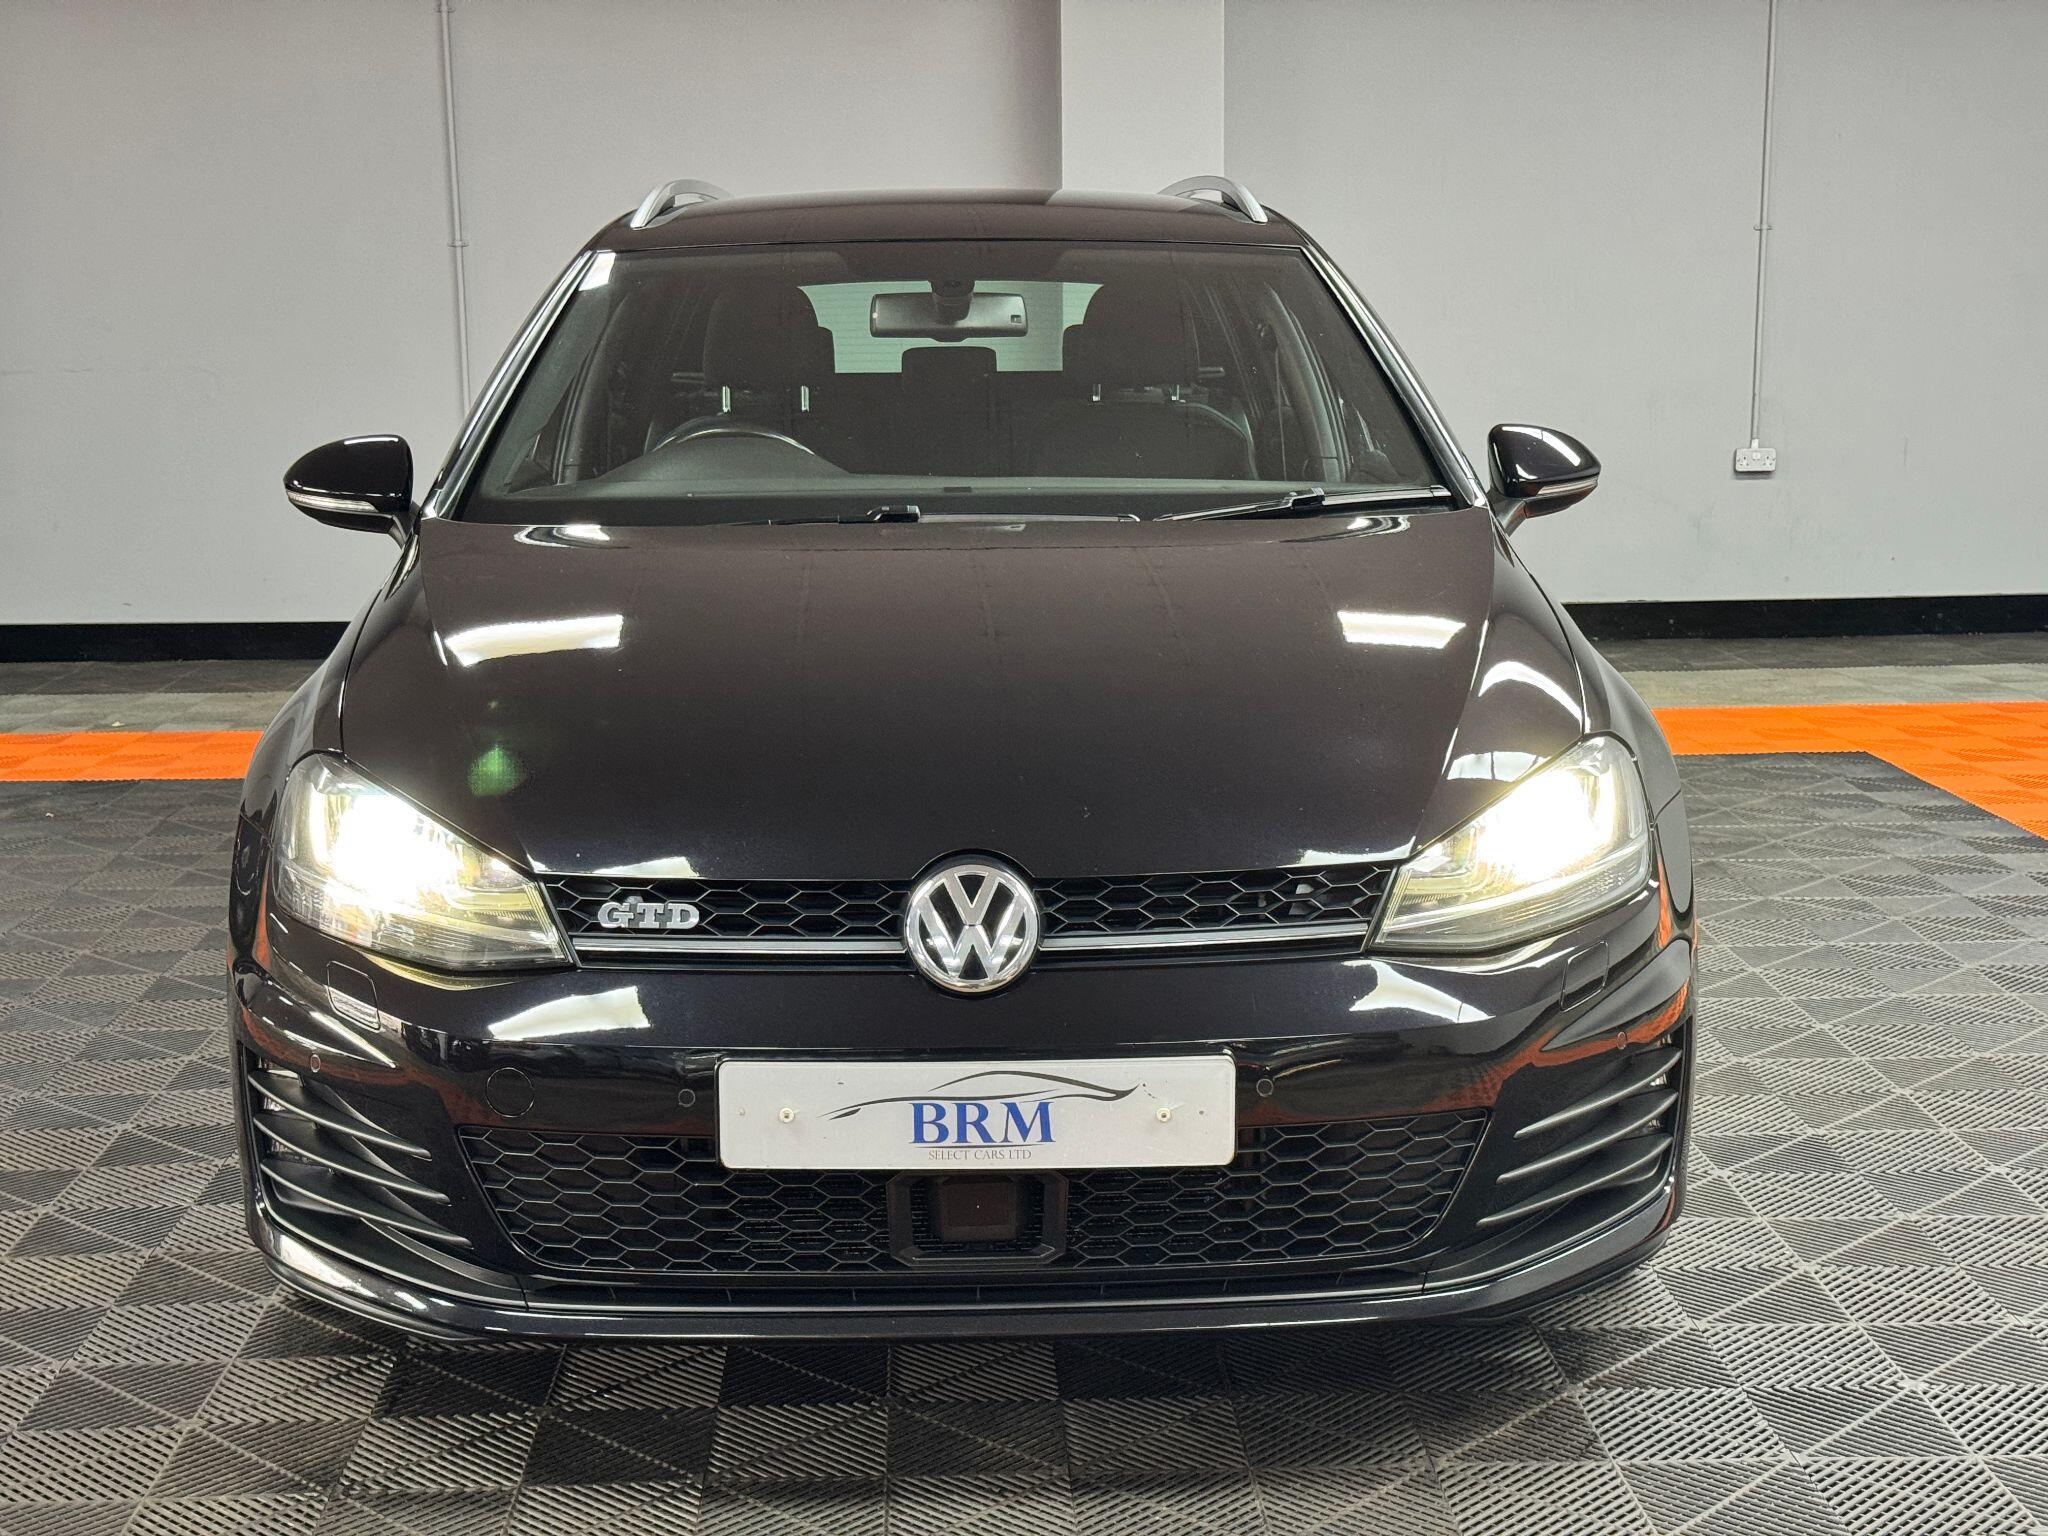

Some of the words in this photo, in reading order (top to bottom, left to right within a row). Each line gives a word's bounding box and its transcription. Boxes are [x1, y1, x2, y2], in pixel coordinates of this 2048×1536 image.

[598, 902, 700, 930] GTD
[908, 1101, 1057, 1144] BRM
[928, 1149, 969, 1161] SELECT
[974, 1149, 1005, 1160] CARS
[1008, 1149, 1032, 1160] LTD
